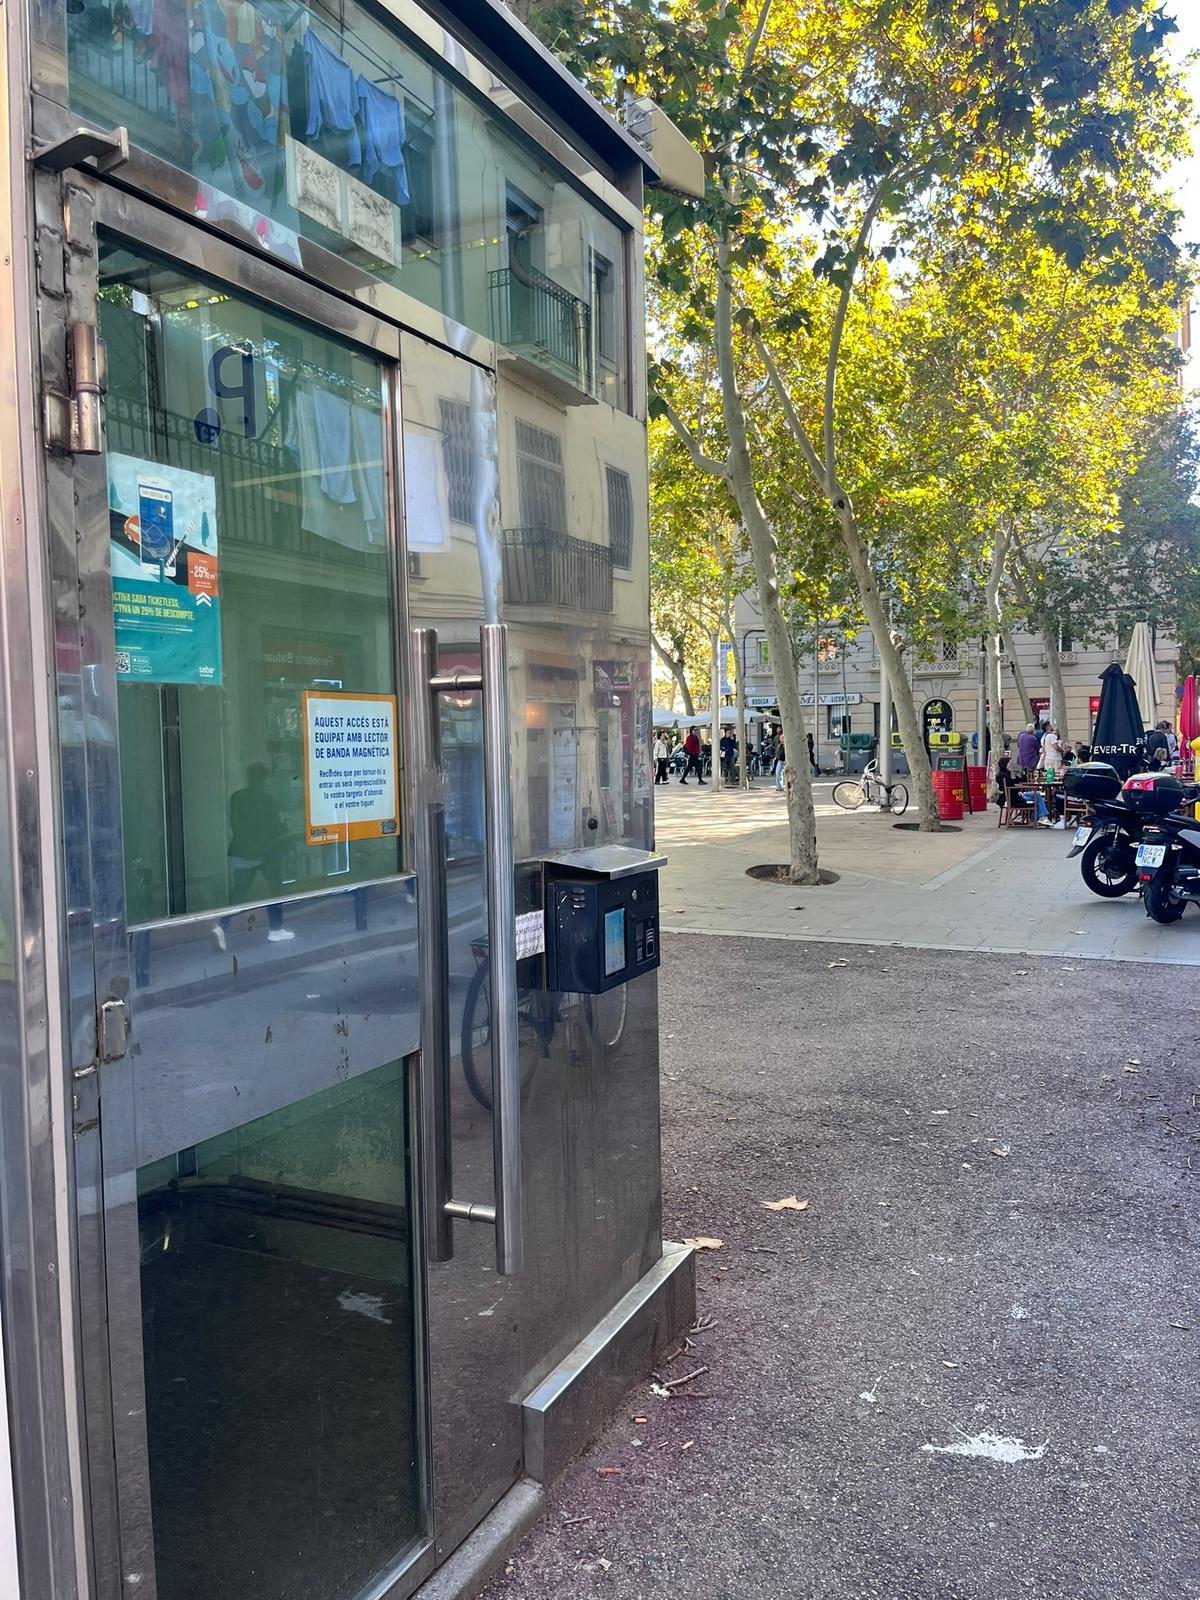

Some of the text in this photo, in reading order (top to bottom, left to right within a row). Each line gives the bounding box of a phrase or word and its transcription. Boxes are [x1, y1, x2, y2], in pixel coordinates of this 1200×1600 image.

[132, 593, 147, 604] SABA
[112, 603, 132, 615] CTIVA
[132, 605, 140, 615] UN
[141, 606, 155, 616] 25%
[155, 607, 162, 617] DE
[315, 717, 344, 728] AQUEST
[346, 716, 370, 728] ACCÉS
[315, 732, 388, 743] EQUIPAT AMB LECTOR
[316, 748, 324, 758] DE
[326, 747, 350, 758] BANDA
[343, 770, 353, 778] que
[319, 781, 334, 789] entrar
[353, 778, 387, 787] imprescindible
[324, 791, 329, 799] la
[330, 791, 345, 799] vostra
[346, 790, 363, 799] targeta
[345, 800, 360, 808] vostre
